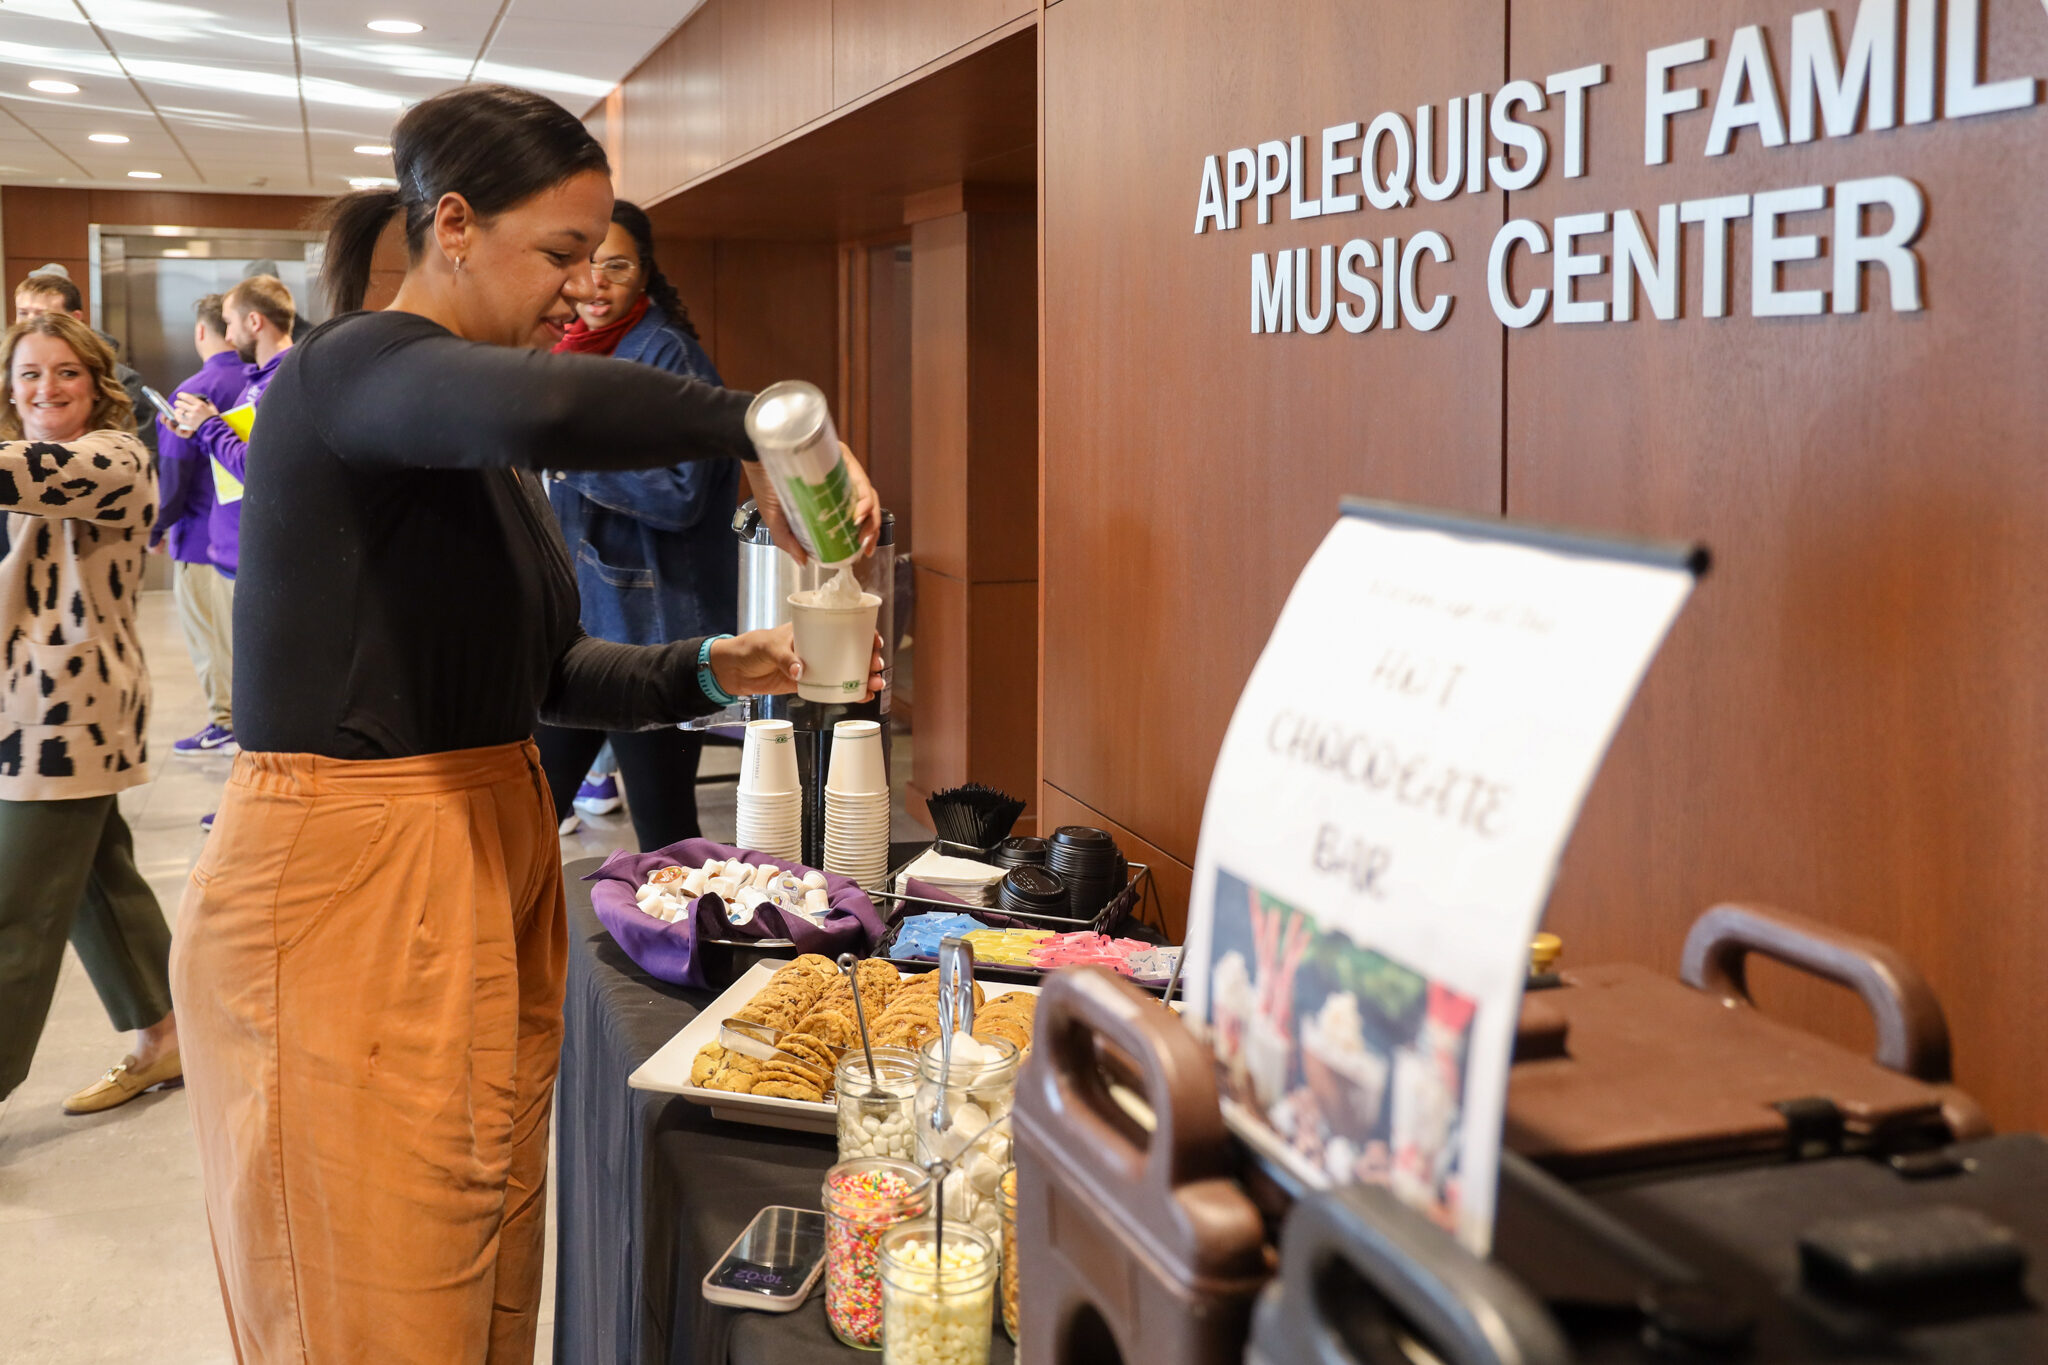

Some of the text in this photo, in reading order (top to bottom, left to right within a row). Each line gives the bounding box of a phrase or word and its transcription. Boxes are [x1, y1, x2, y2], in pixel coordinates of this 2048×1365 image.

[1194, 0, 2048, 234] APPLEQUIST FAMIL
[1251, 175, 1925, 334] MUSIC CENTER
[735, 1269, 782, 1284] 10:02
